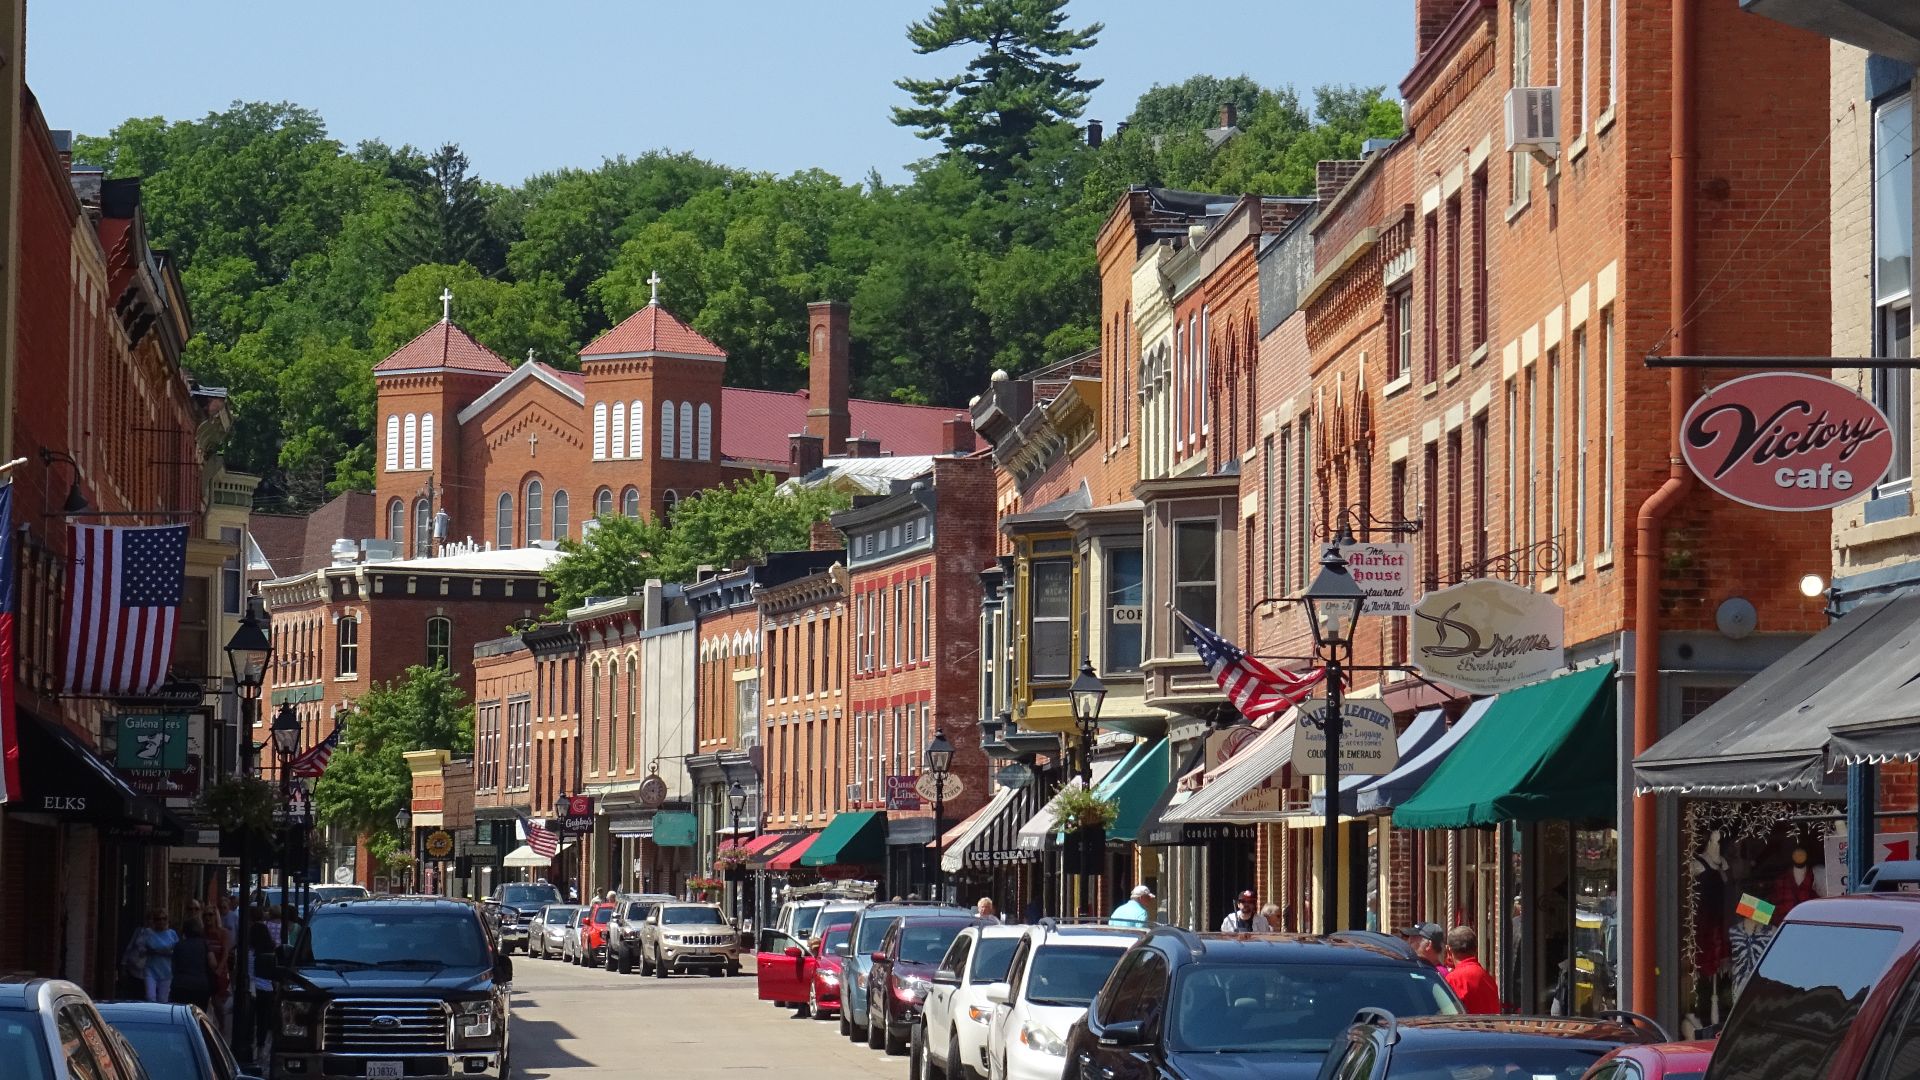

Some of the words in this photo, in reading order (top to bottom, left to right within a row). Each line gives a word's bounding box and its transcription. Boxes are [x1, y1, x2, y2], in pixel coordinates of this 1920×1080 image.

[1687, 400, 1889, 480] Victory
[1774, 463, 1853, 490] cafe
[1365, 547, 1384, 556] The
[1347, 553, 1404, 567] Market
[1353, 568, 1401, 583] House
[1371, 601, 1391, 611] North
[1391, 601, 1411, 611] Main
[1415, 602, 1558, 658] Dreams
[1457, 656, 1516, 675] Boutique
[125, 717, 159, 729] Galena
[1344, 703, 1390, 730] LEATHER
[1347, 749, 1382, 759] EMERALDS
[887, 776, 917, 788] Outsid
[894, 787, 920, 800] Lines
[43, 796, 87, 810] ELKS
[1186, 826, 1218, 839] candle
[1234, 826, 1256, 838] bath
[970, 851, 991, 861] ICE
[992, 850, 1035, 860] CREAM
